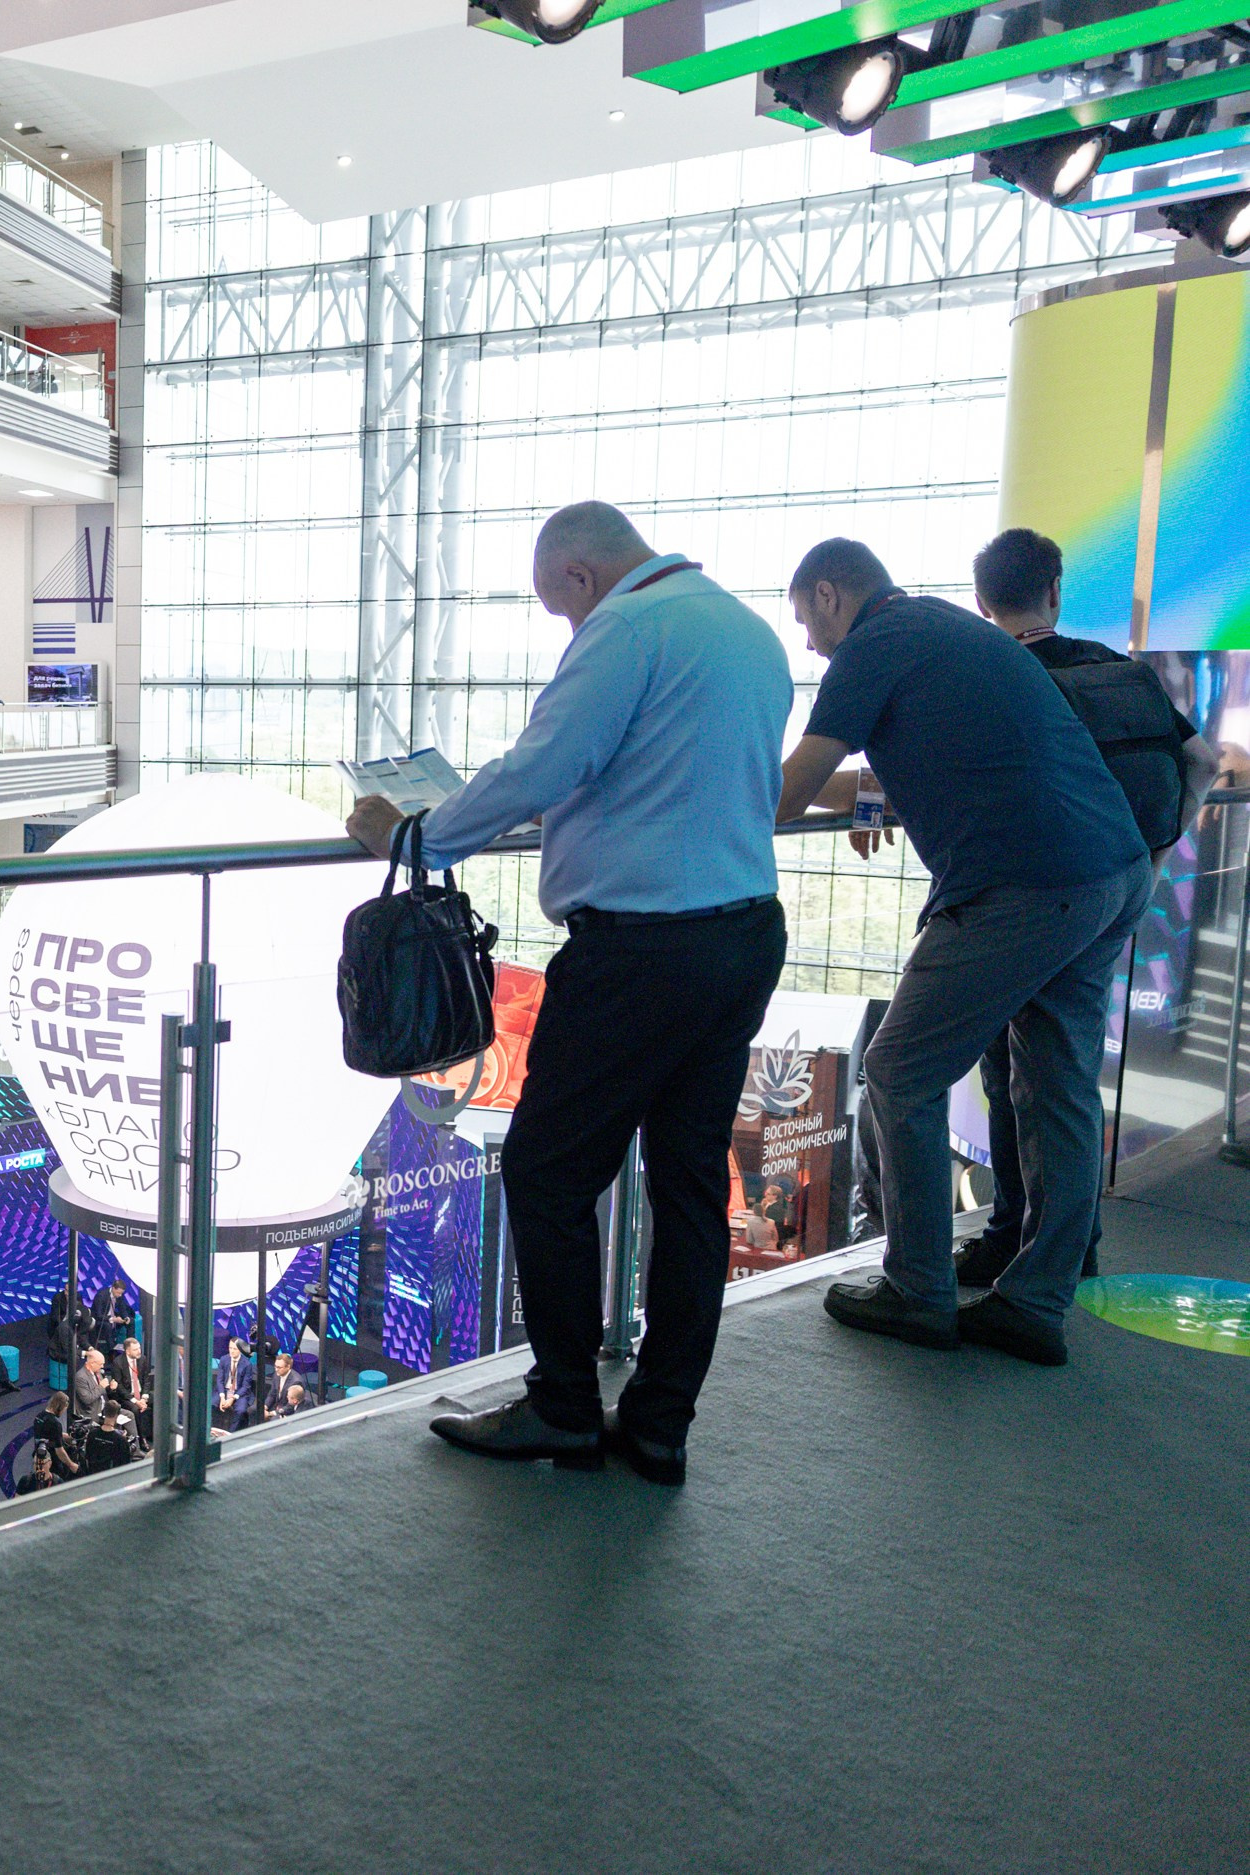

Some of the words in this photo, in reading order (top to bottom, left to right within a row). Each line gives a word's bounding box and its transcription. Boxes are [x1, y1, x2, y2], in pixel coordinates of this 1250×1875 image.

[33, 932, 153, 979] ПРО
[30, 977, 147, 1025] СВЕ
[31, 1018, 125, 1063] ЩЕ
[39, 1060, 162, 1107] НИЕ
[762, 1124, 848, 1160] ЭКОНОМИЧЕСКИЙ
[763, 1112, 823, 1142] ВОСТОЧНЫЙ
[5, 1152, 44, 1171] РОСТА
[372, 1151, 502, 1200] ROSCONGRE
[761, 1156, 797, 1178] ФОРУМ
[372, 1205, 399, 1220] Time
[399, 1203, 411, 1214] to
[411, 1197, 430, 1211] Act
[265, 1218, 335, 1245] ПОДЪЕМНАЯ
[335, 1212, 354, 1233] СИЛА
